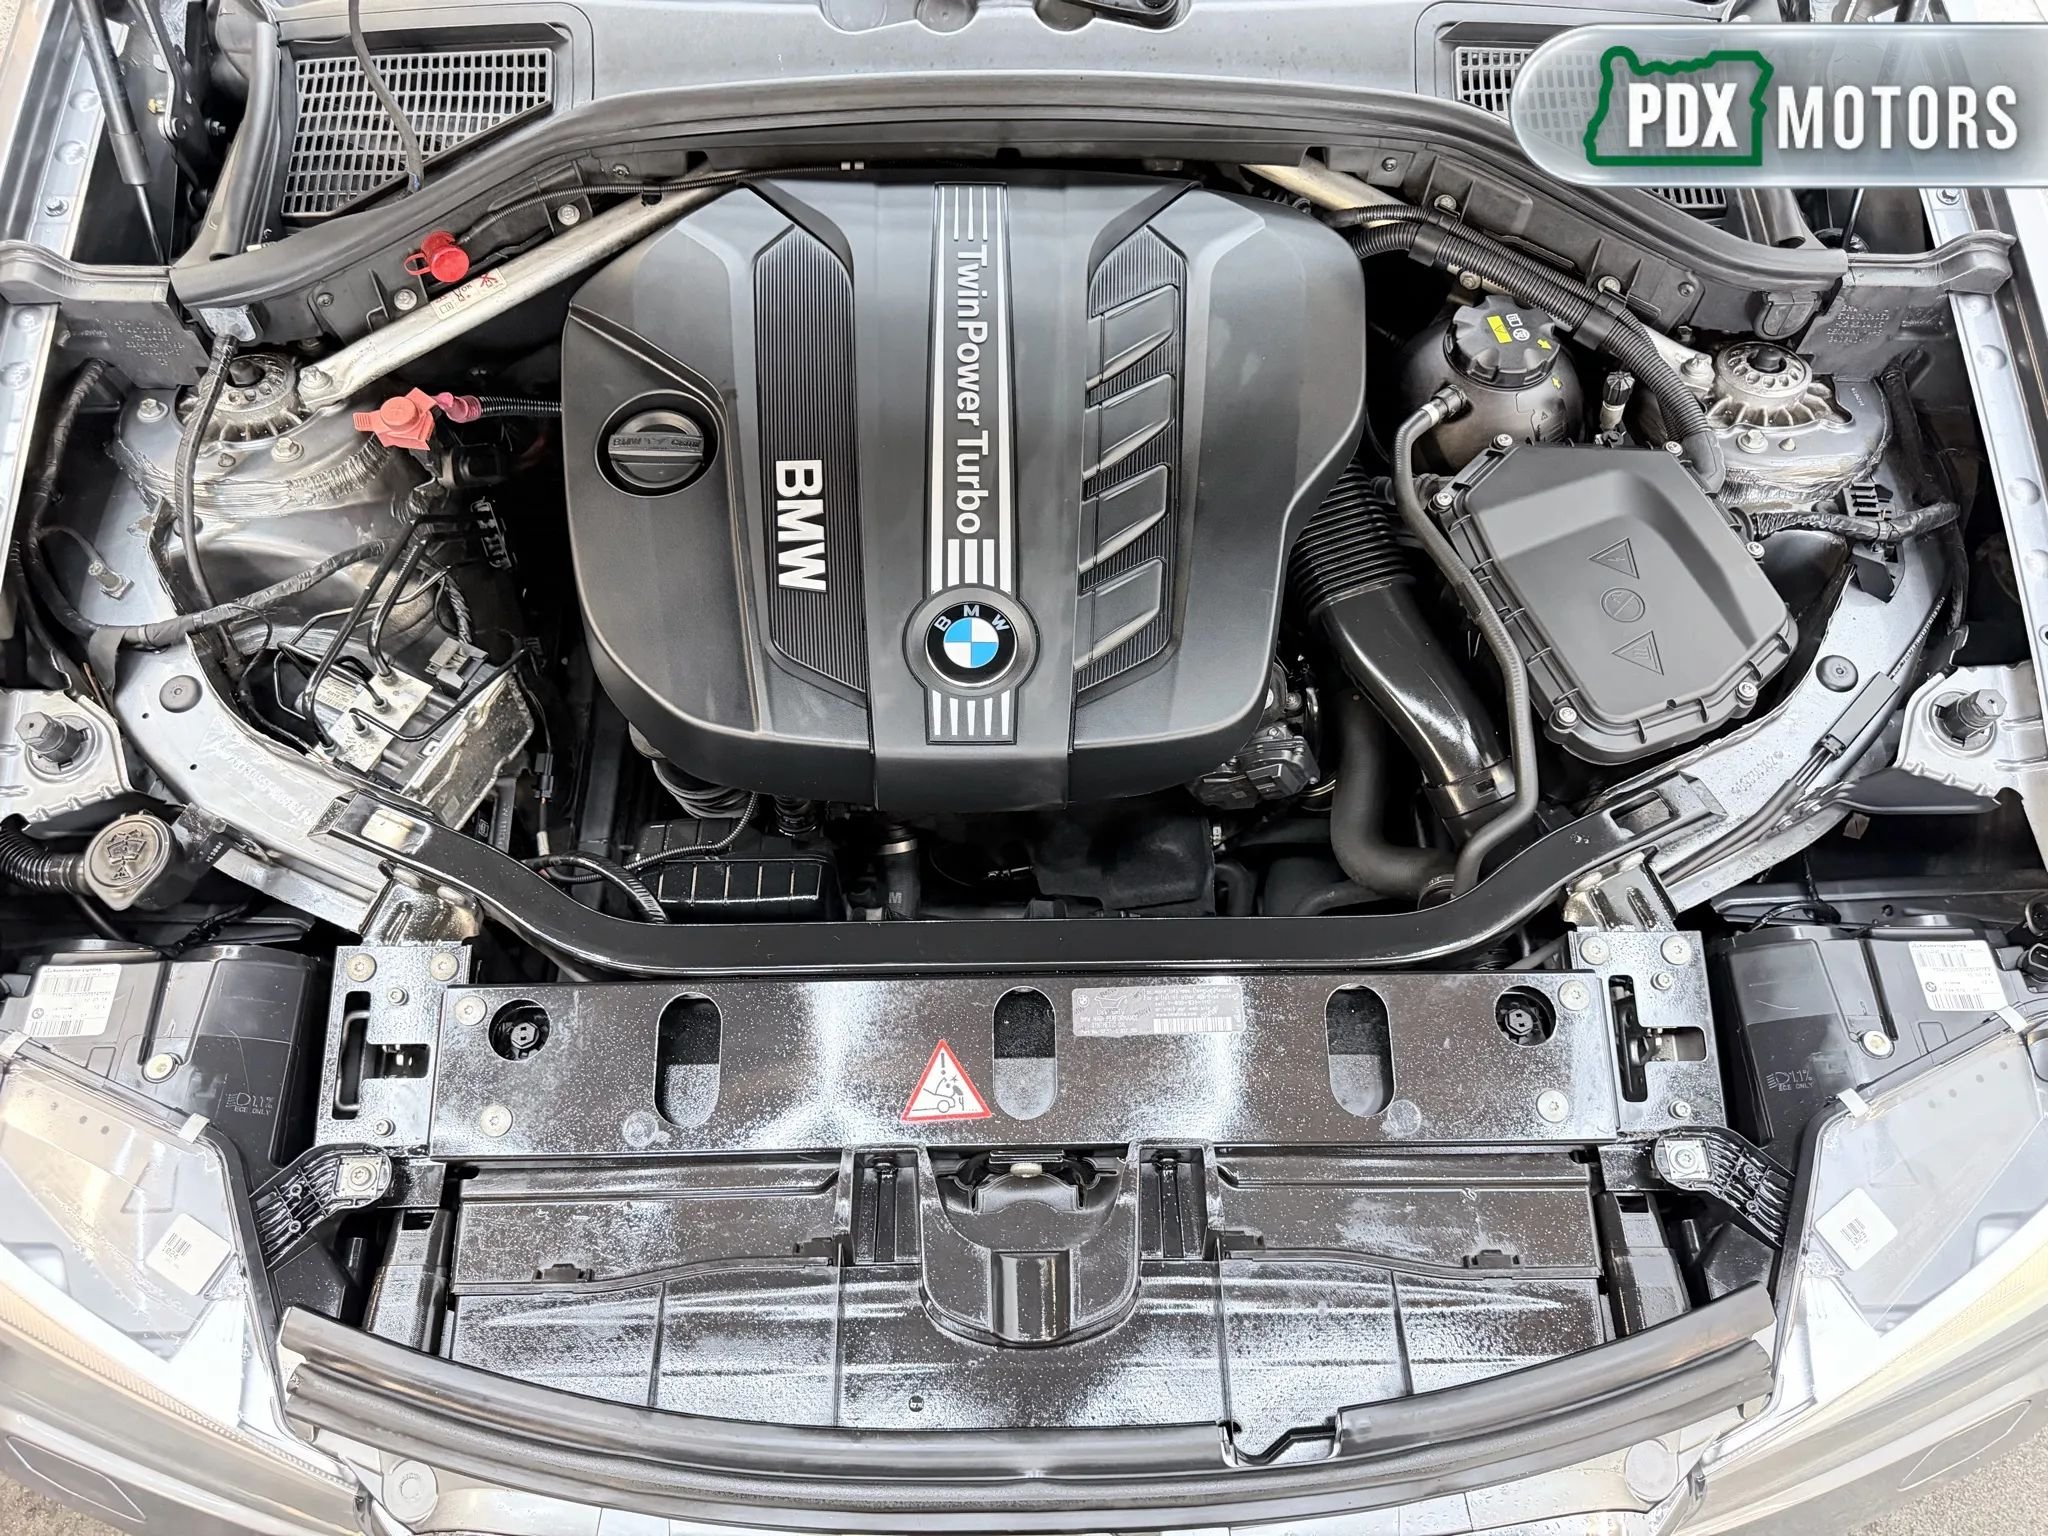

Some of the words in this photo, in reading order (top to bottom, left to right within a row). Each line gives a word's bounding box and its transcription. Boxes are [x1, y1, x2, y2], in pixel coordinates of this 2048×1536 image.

[956, 244, 988, 426] TwinPower
[776, 459, 826, 592] BMW
[956, 430, 989, 534] Turbo
[933, 604, 1010, 632] BMW
